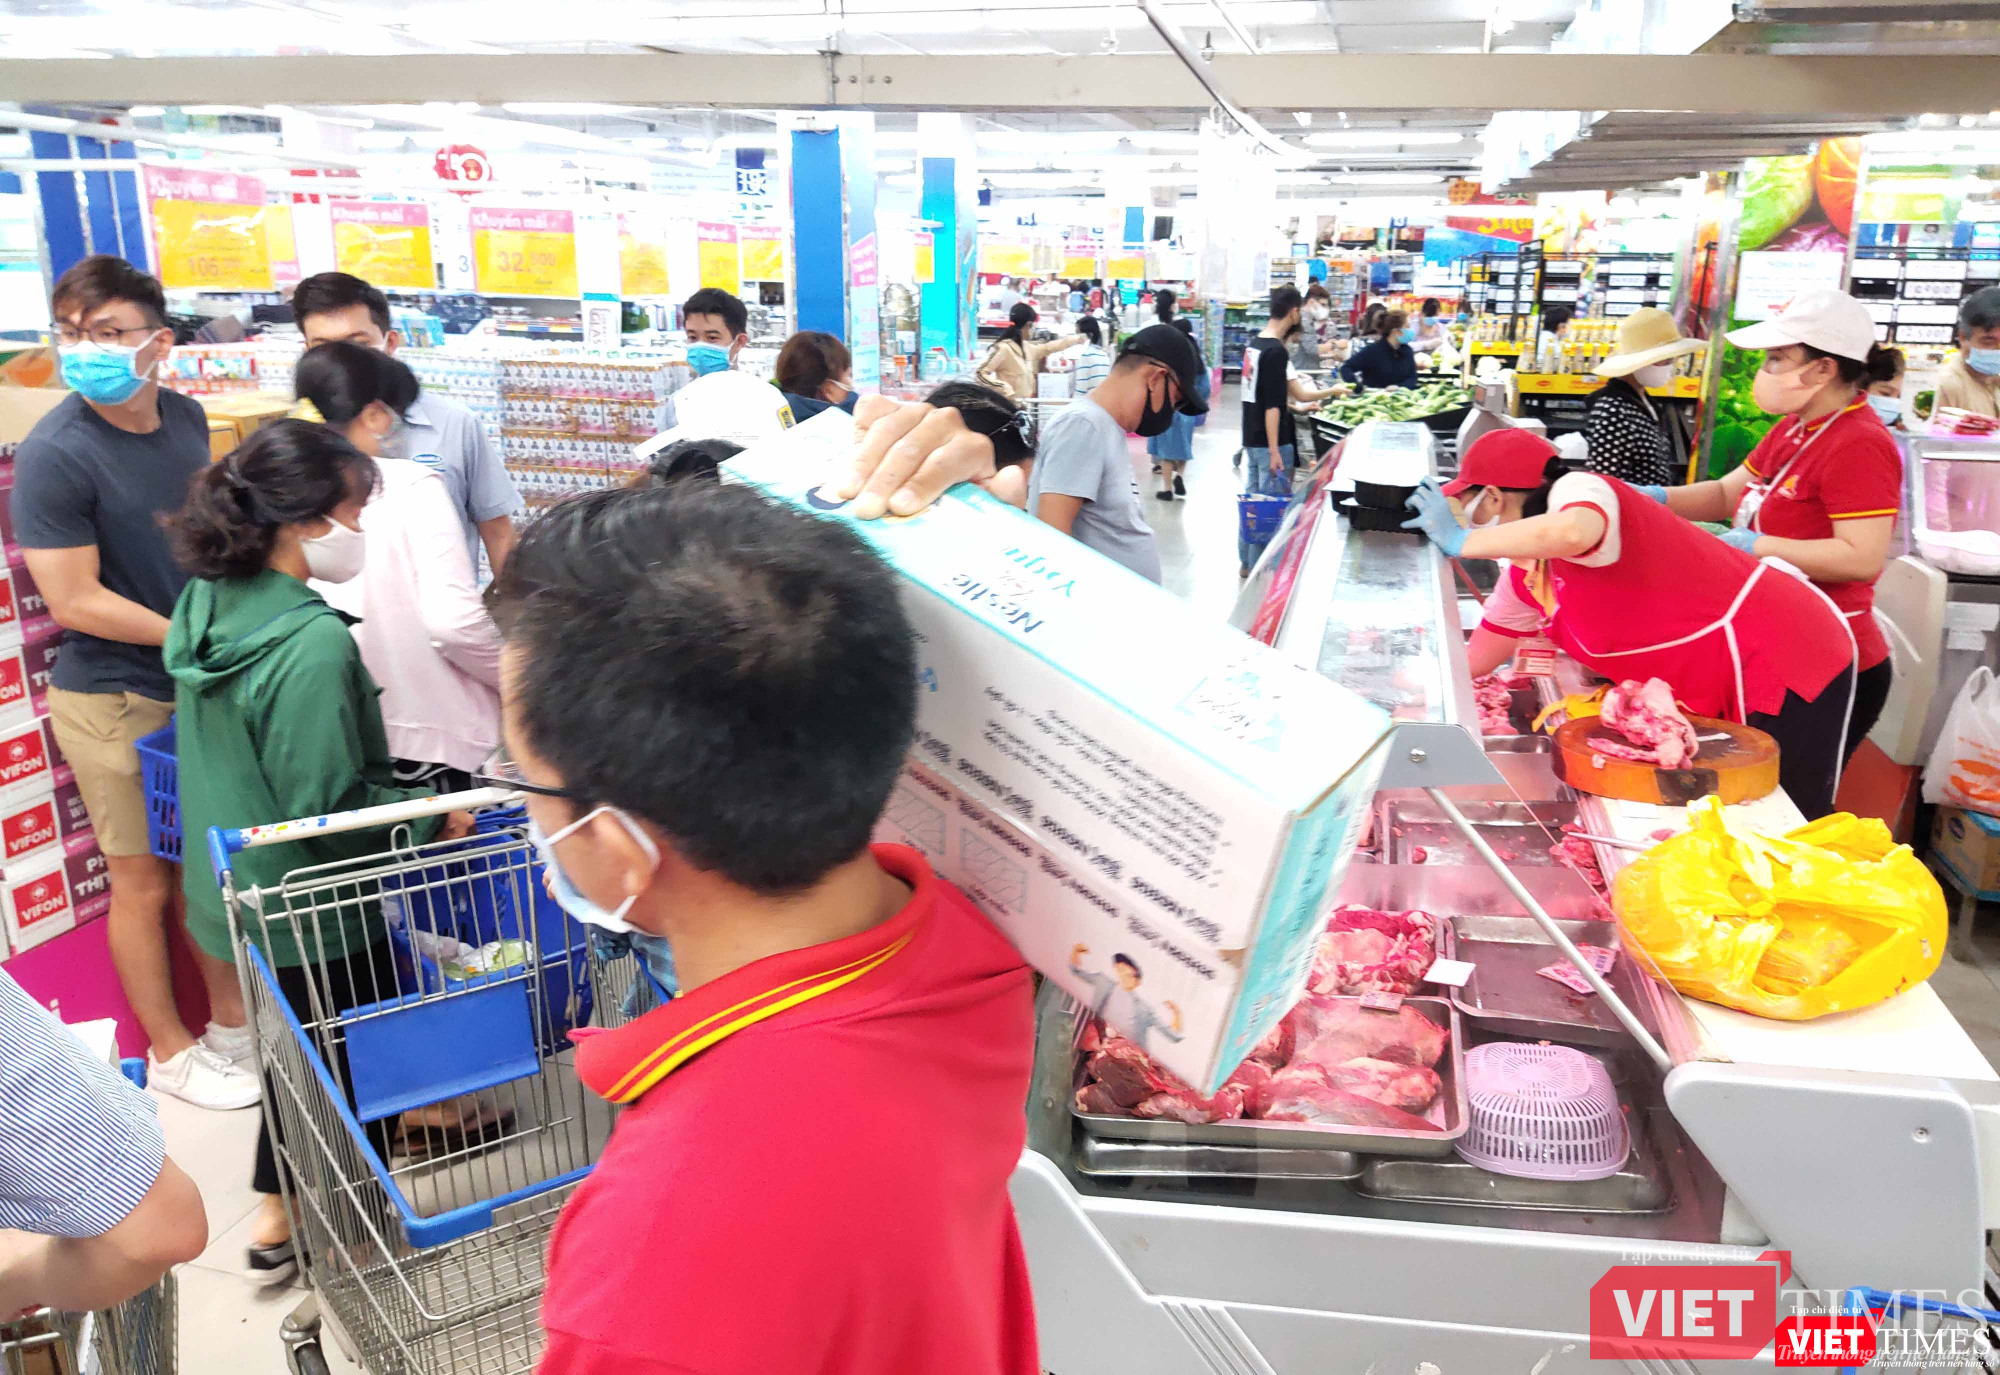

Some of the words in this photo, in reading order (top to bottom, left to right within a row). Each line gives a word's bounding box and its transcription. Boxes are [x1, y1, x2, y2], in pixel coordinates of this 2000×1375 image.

[0, 755, 43, 781] VIFON
[8, 826, 53, 853] VIFON
[21, 894, 65, 921] VIFON
